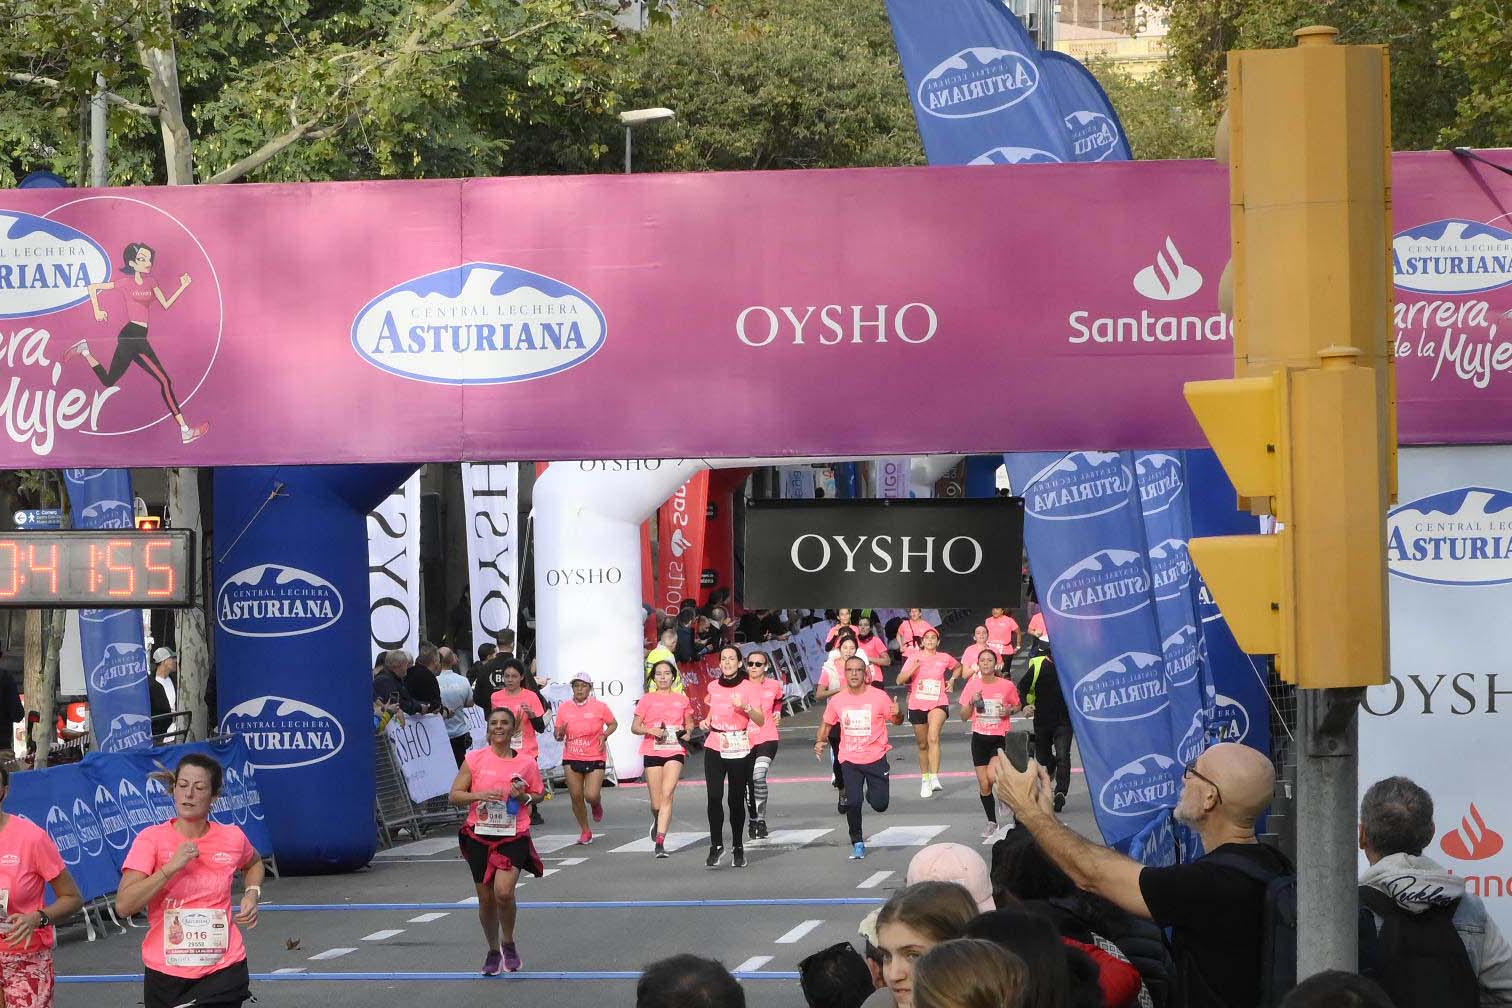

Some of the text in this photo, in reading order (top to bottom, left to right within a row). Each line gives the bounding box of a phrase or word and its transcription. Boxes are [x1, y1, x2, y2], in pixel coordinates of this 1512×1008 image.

[14, 245, 87, 257] LECHERA
[1408, 245, 1460, 254] CENTRAL
[411, 302, 579, 319] CENTRAL LECHERA
[1393, 301, 1489, 328] arrera
[371, 310, 587, 354] ASTURIANA
[735, 302, 938, 347] OYSHO
[1069, 309, 1235, 344] Santand
[1418, 331, 1435, 357] la
[1431, 324, 1512, 389] Muje
[1416, 522, 1482, 532] CENTRAL
[790, 533, 983, 574] OYSHO
[1388, 525, 1512, 561] ASTURI
[546, 566, 622, 587] OYSHO
[233, 588, 329, 597] CENTRAL LECHERA
[221, 594, 334, 620] ASTURIANA
[1361, 672, 1512, 716] OYSH
[281, 720, 330, 728] LECHERA
[243, 731, 335, 750] TURIANA
[186, 931, 207, 939] 016
